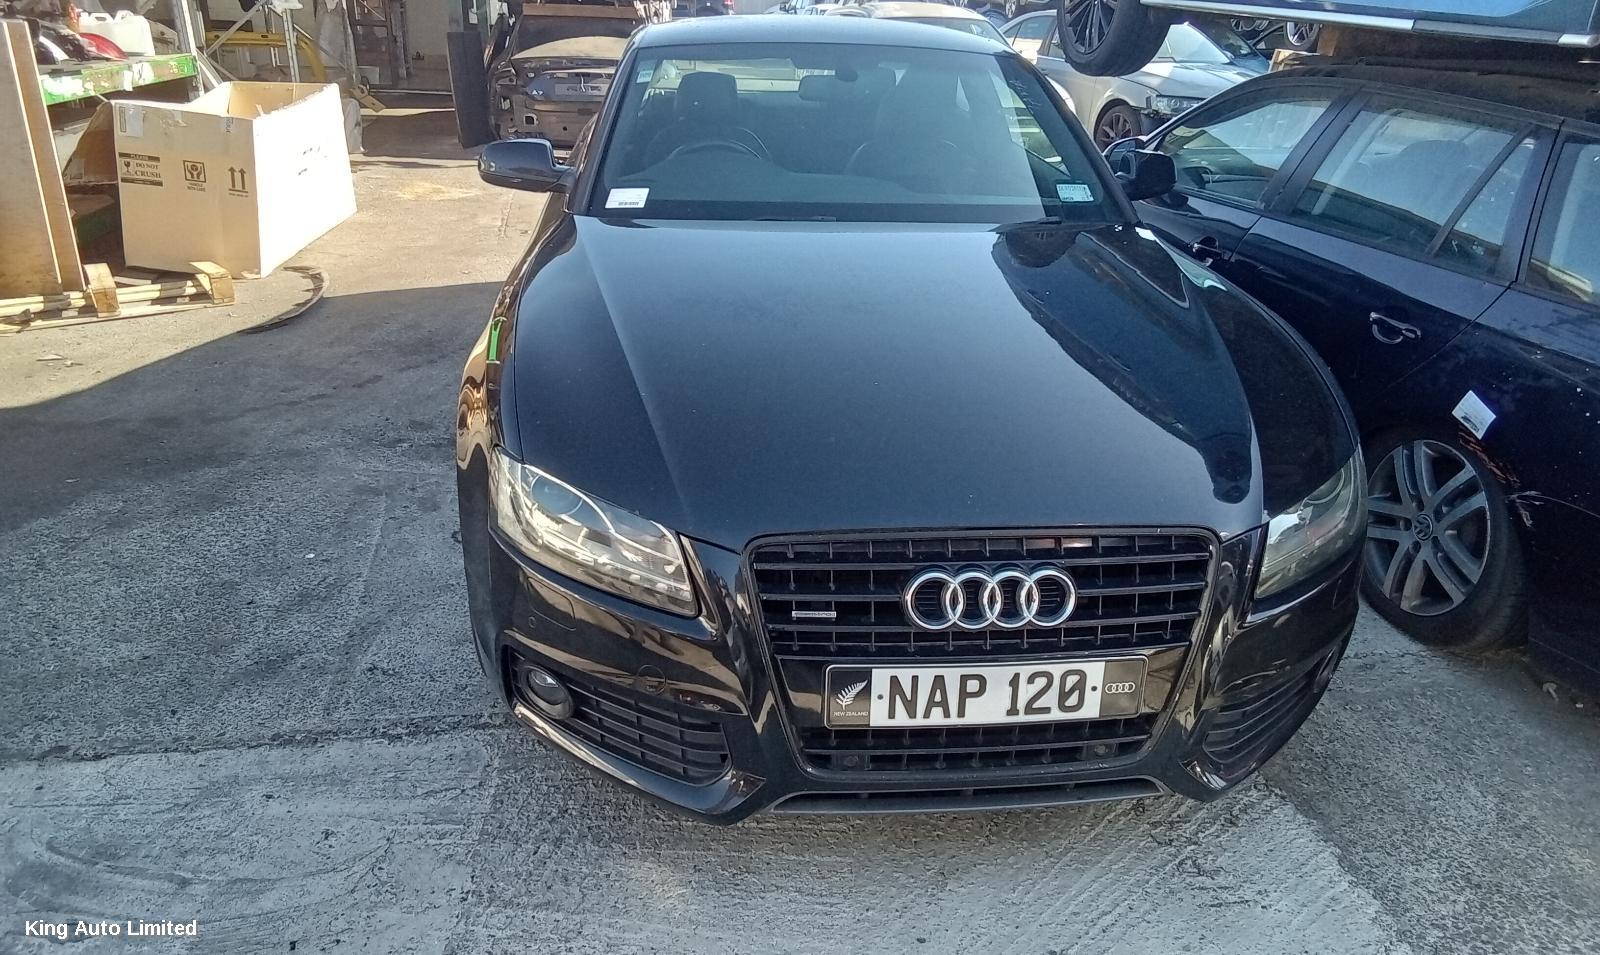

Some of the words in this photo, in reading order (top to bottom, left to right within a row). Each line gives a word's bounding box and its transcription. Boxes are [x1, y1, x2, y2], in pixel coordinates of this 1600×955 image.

[134, 170, 161, 179] CRUSH
[887, 674, 988, 720] NAP
[1006, 668, 1088, 716] 120
